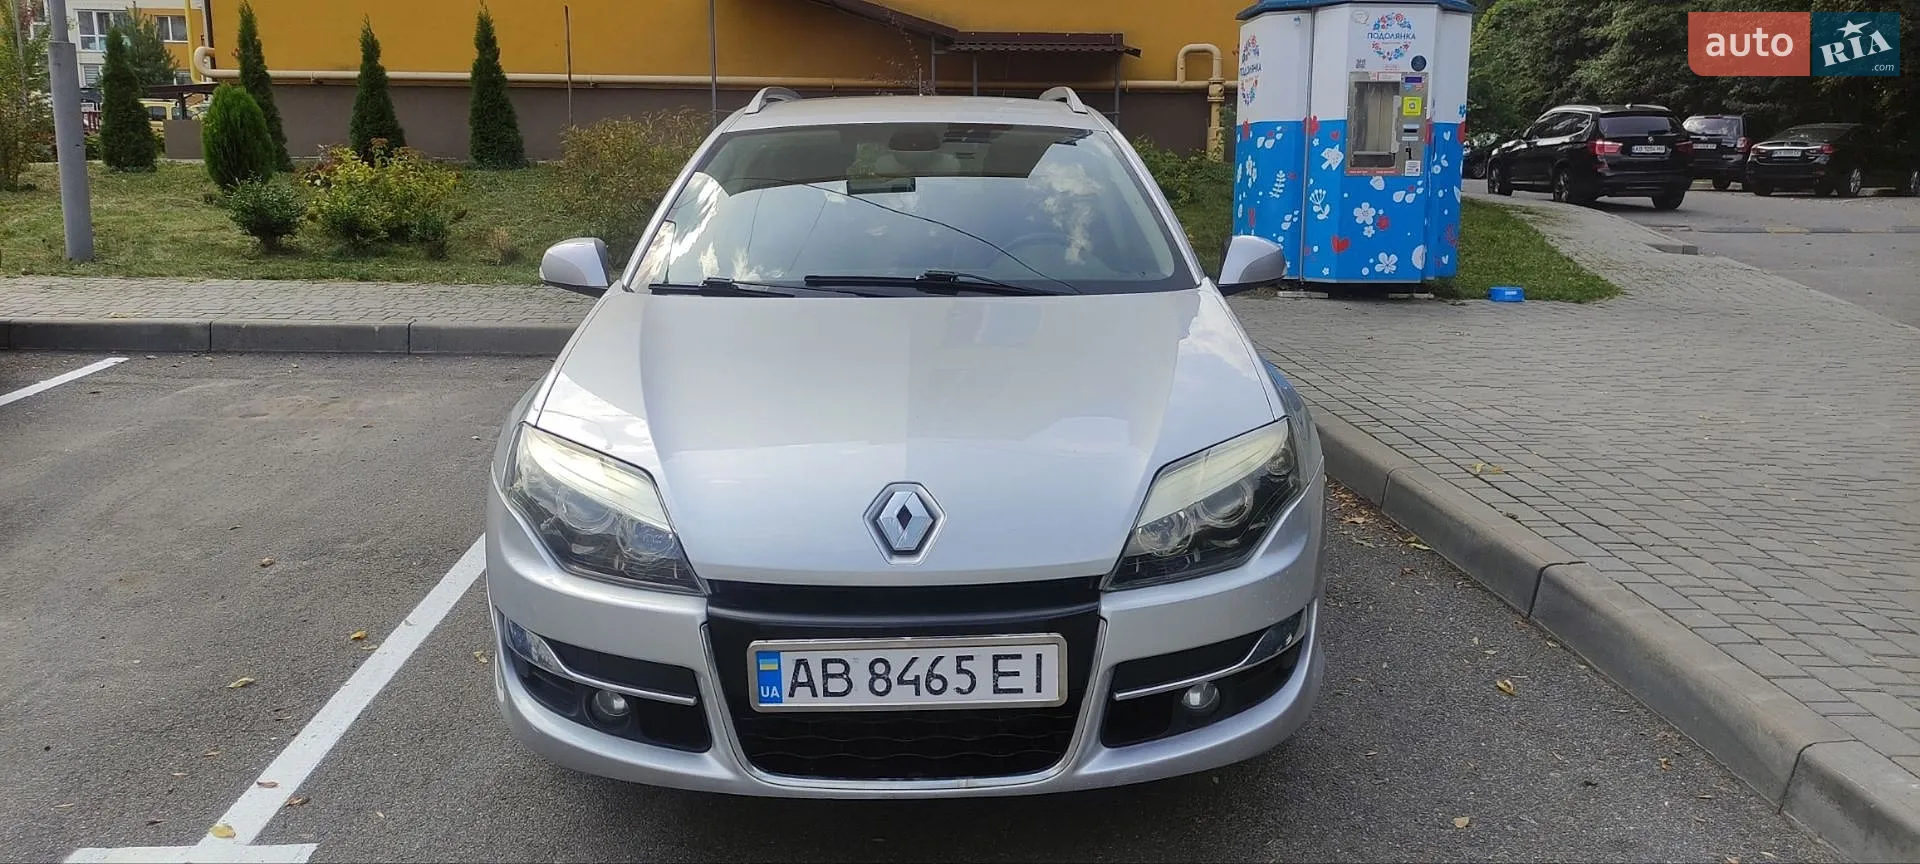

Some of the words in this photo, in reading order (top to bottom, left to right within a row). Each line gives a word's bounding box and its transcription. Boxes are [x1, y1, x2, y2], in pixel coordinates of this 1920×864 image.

[1367, 32, 1416, 40] ПОДОЛЯНКА
[788, 658, 853, 698] AB
[868, 655, 977, 697] 8465
[992, 653, 1043, 695] EI
[760, 687, 780, 699] UA
